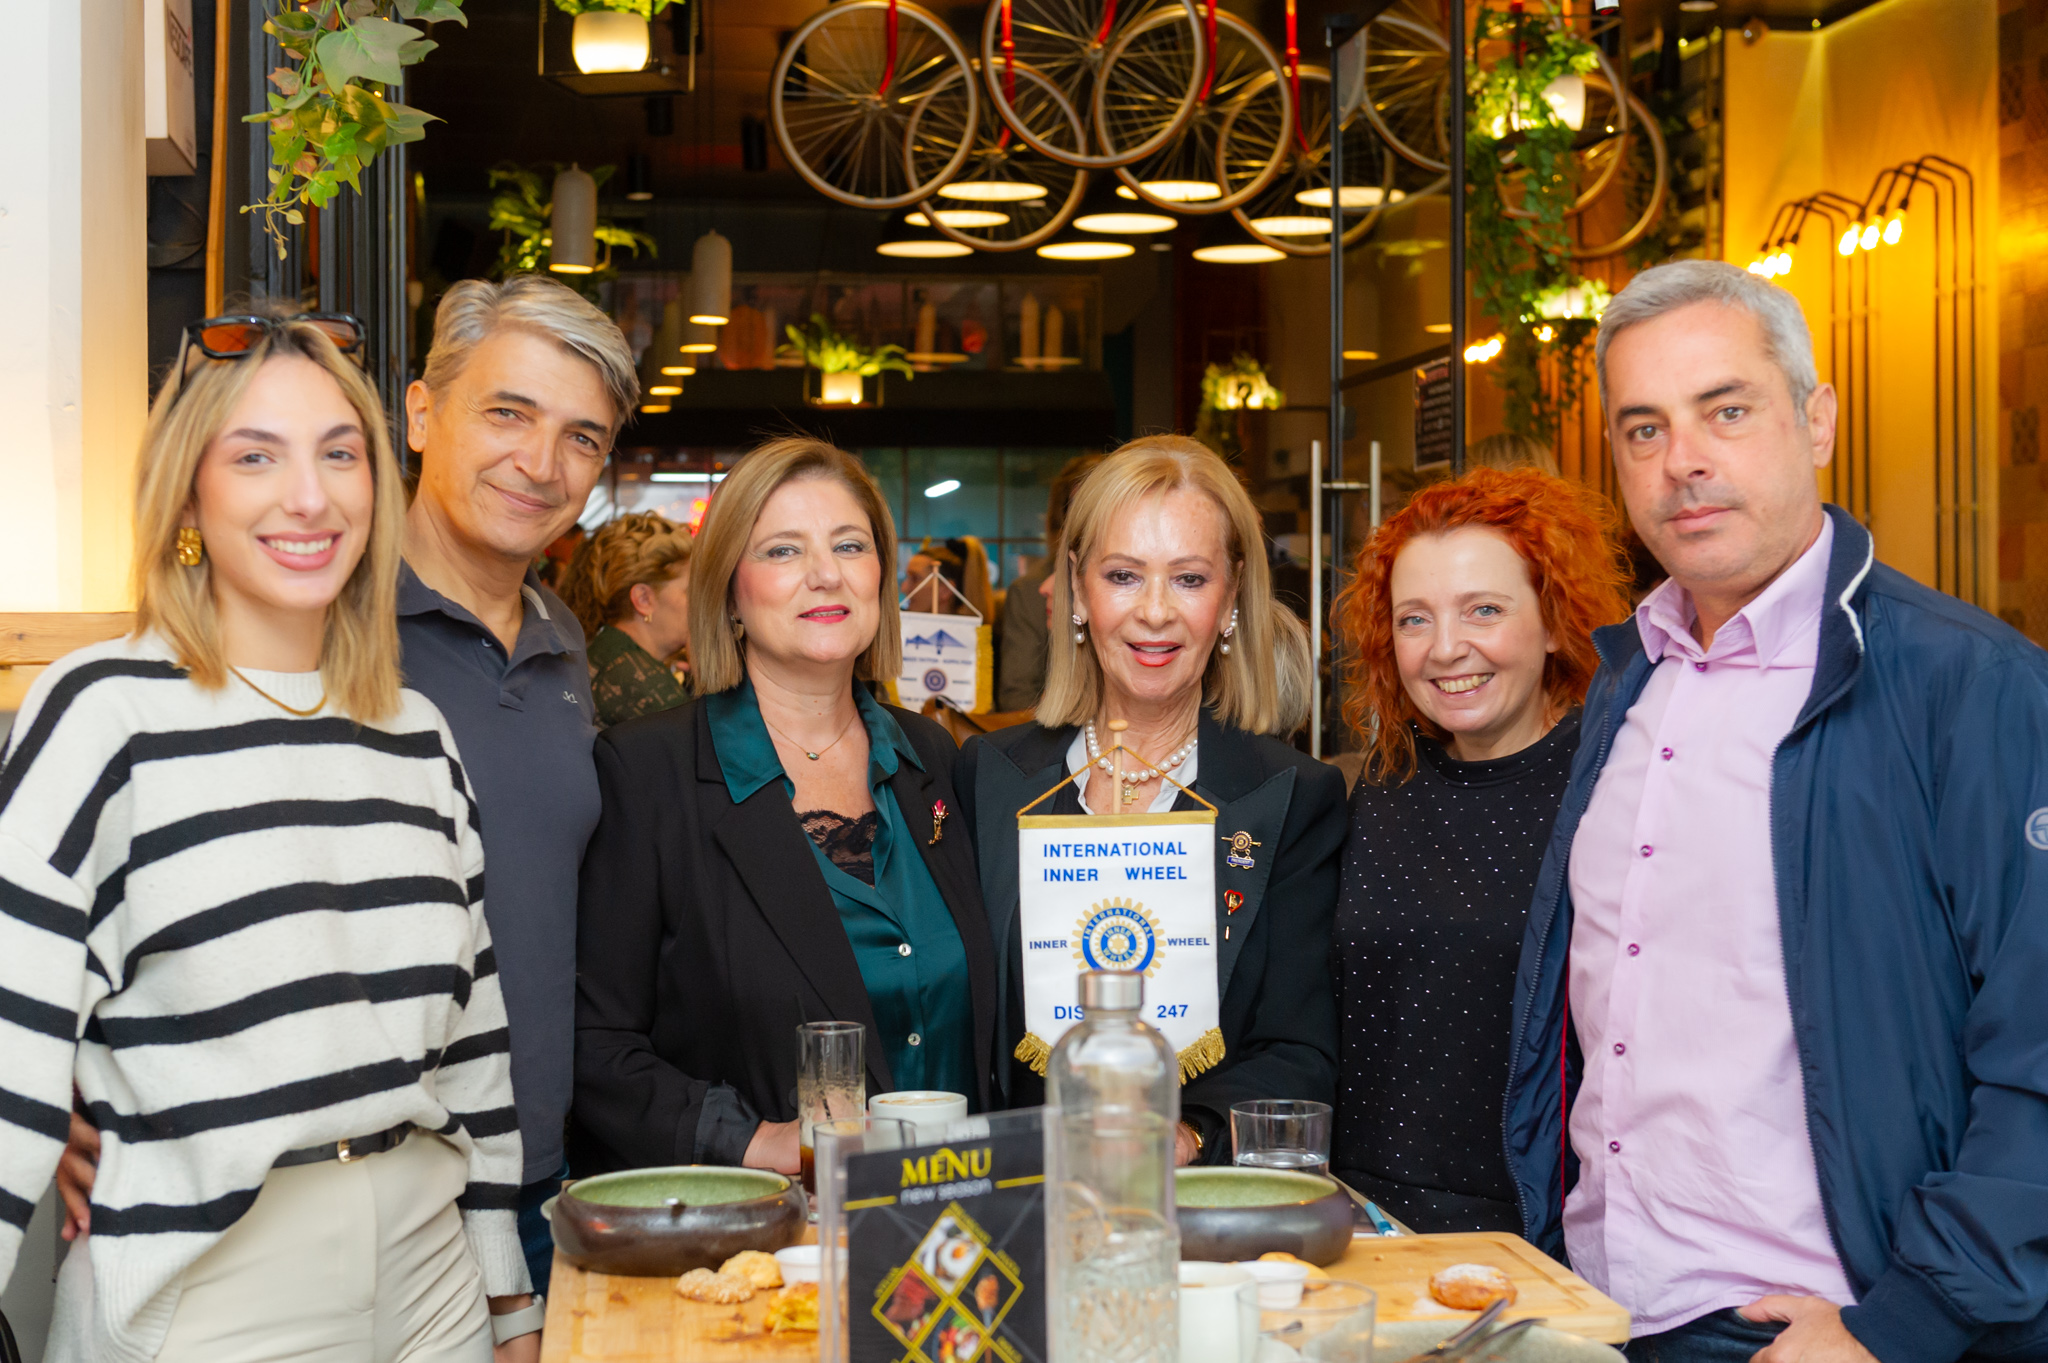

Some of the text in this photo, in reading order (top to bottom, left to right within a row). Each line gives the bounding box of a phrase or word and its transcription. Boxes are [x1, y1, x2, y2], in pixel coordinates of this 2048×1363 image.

[1043, 841, 1187, 858] INTERNATIONAL
[1043, 866, 1188, 882] INNER WHEEL
[1083, 908, 1153, 940] INTERNATIONAL
[1104, 926, 1132, 939] INNER
[1029, 937, 1210, 950] INNER WHEEL
[1103, 947, 1135, 962] WHEEL
[1157, 1004, 1189, 1018] 247
[901, 1147, 992, 1188] MENU
